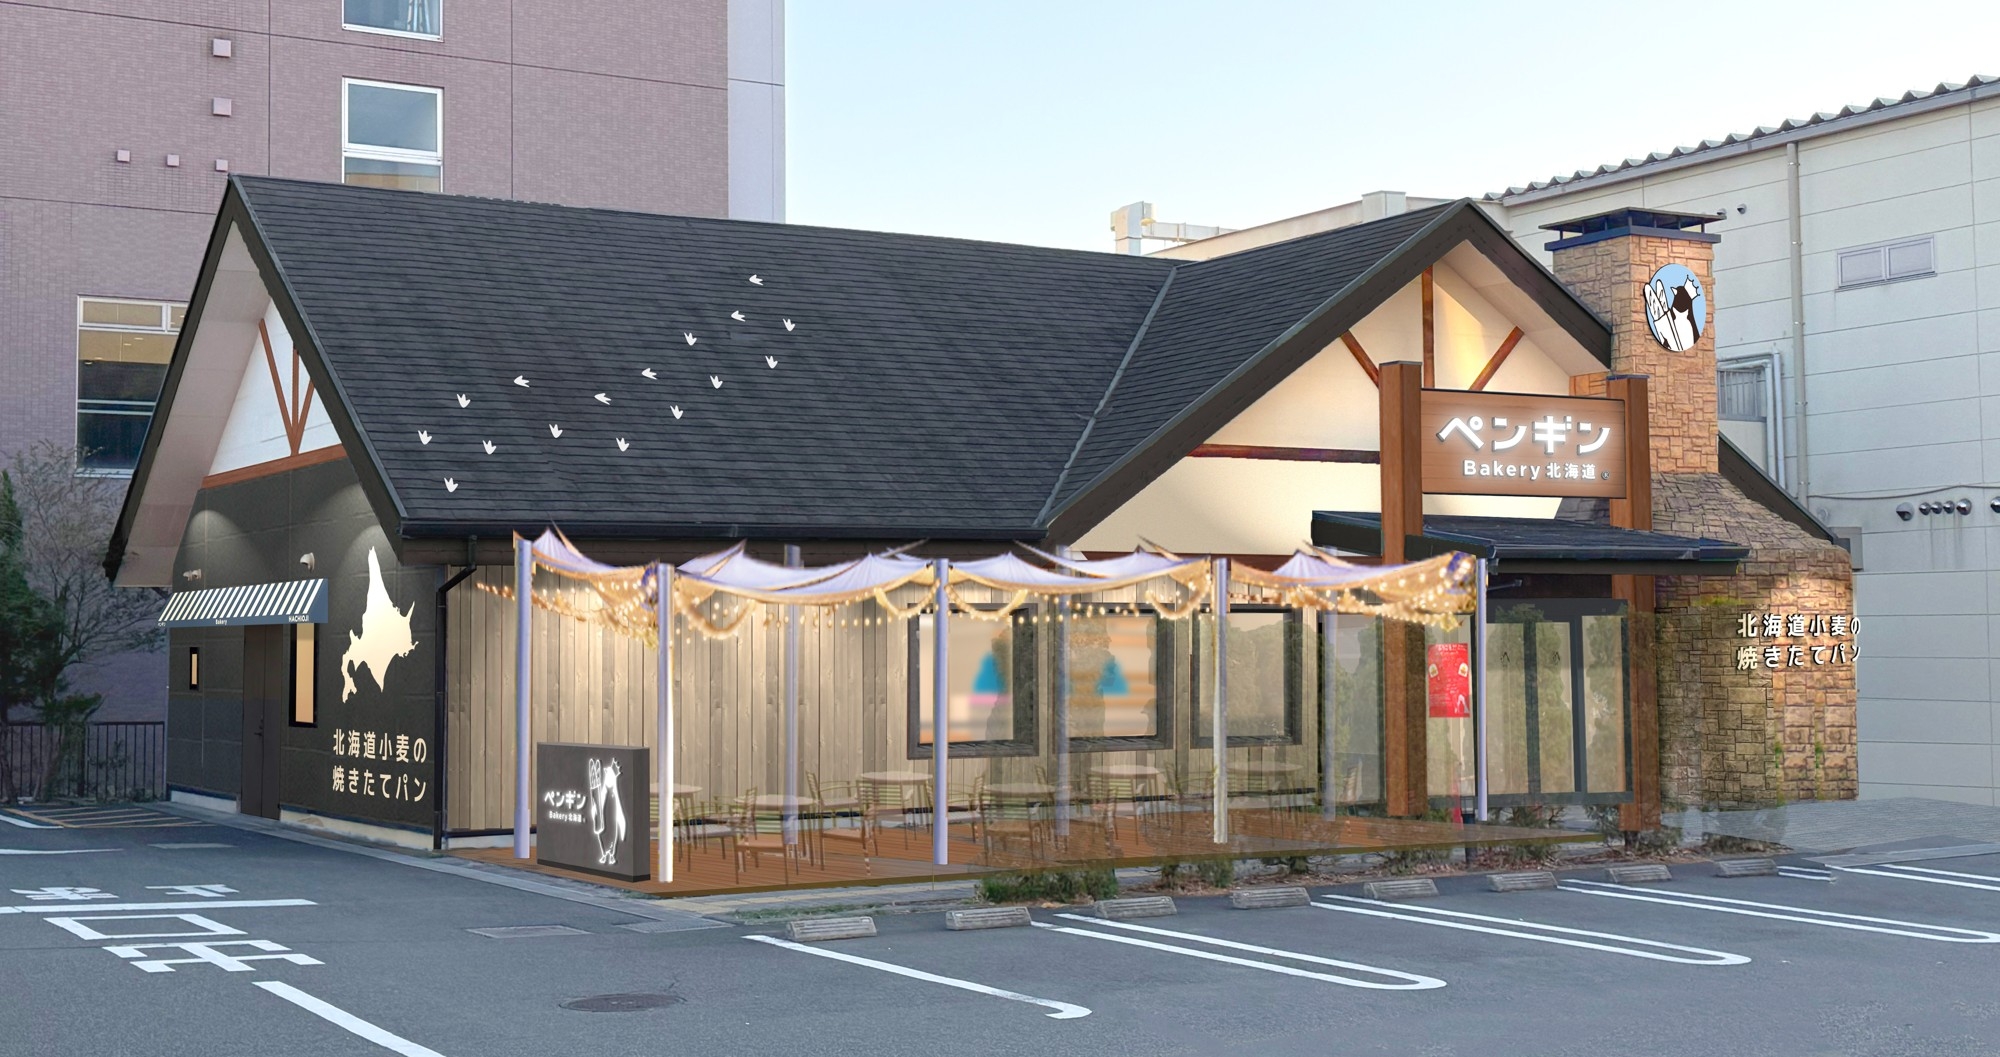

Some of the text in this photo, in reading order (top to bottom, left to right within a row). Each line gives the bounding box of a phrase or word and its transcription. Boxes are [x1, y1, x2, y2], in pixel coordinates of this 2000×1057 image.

[1436, 415, 1611, 455] ペンギン
[1463, 460, 1596, 481] Bakery 北海道
[1737, 613, 1861, 638] 北海道小麦の
[1737, 644, 1861, 671] 焼きたてパン
[332, 728, 428, 763] 北海道小麦の
[332, 765, 427, 802] 焼きたてパン
[544, 790, 586, 809] ペンギン
